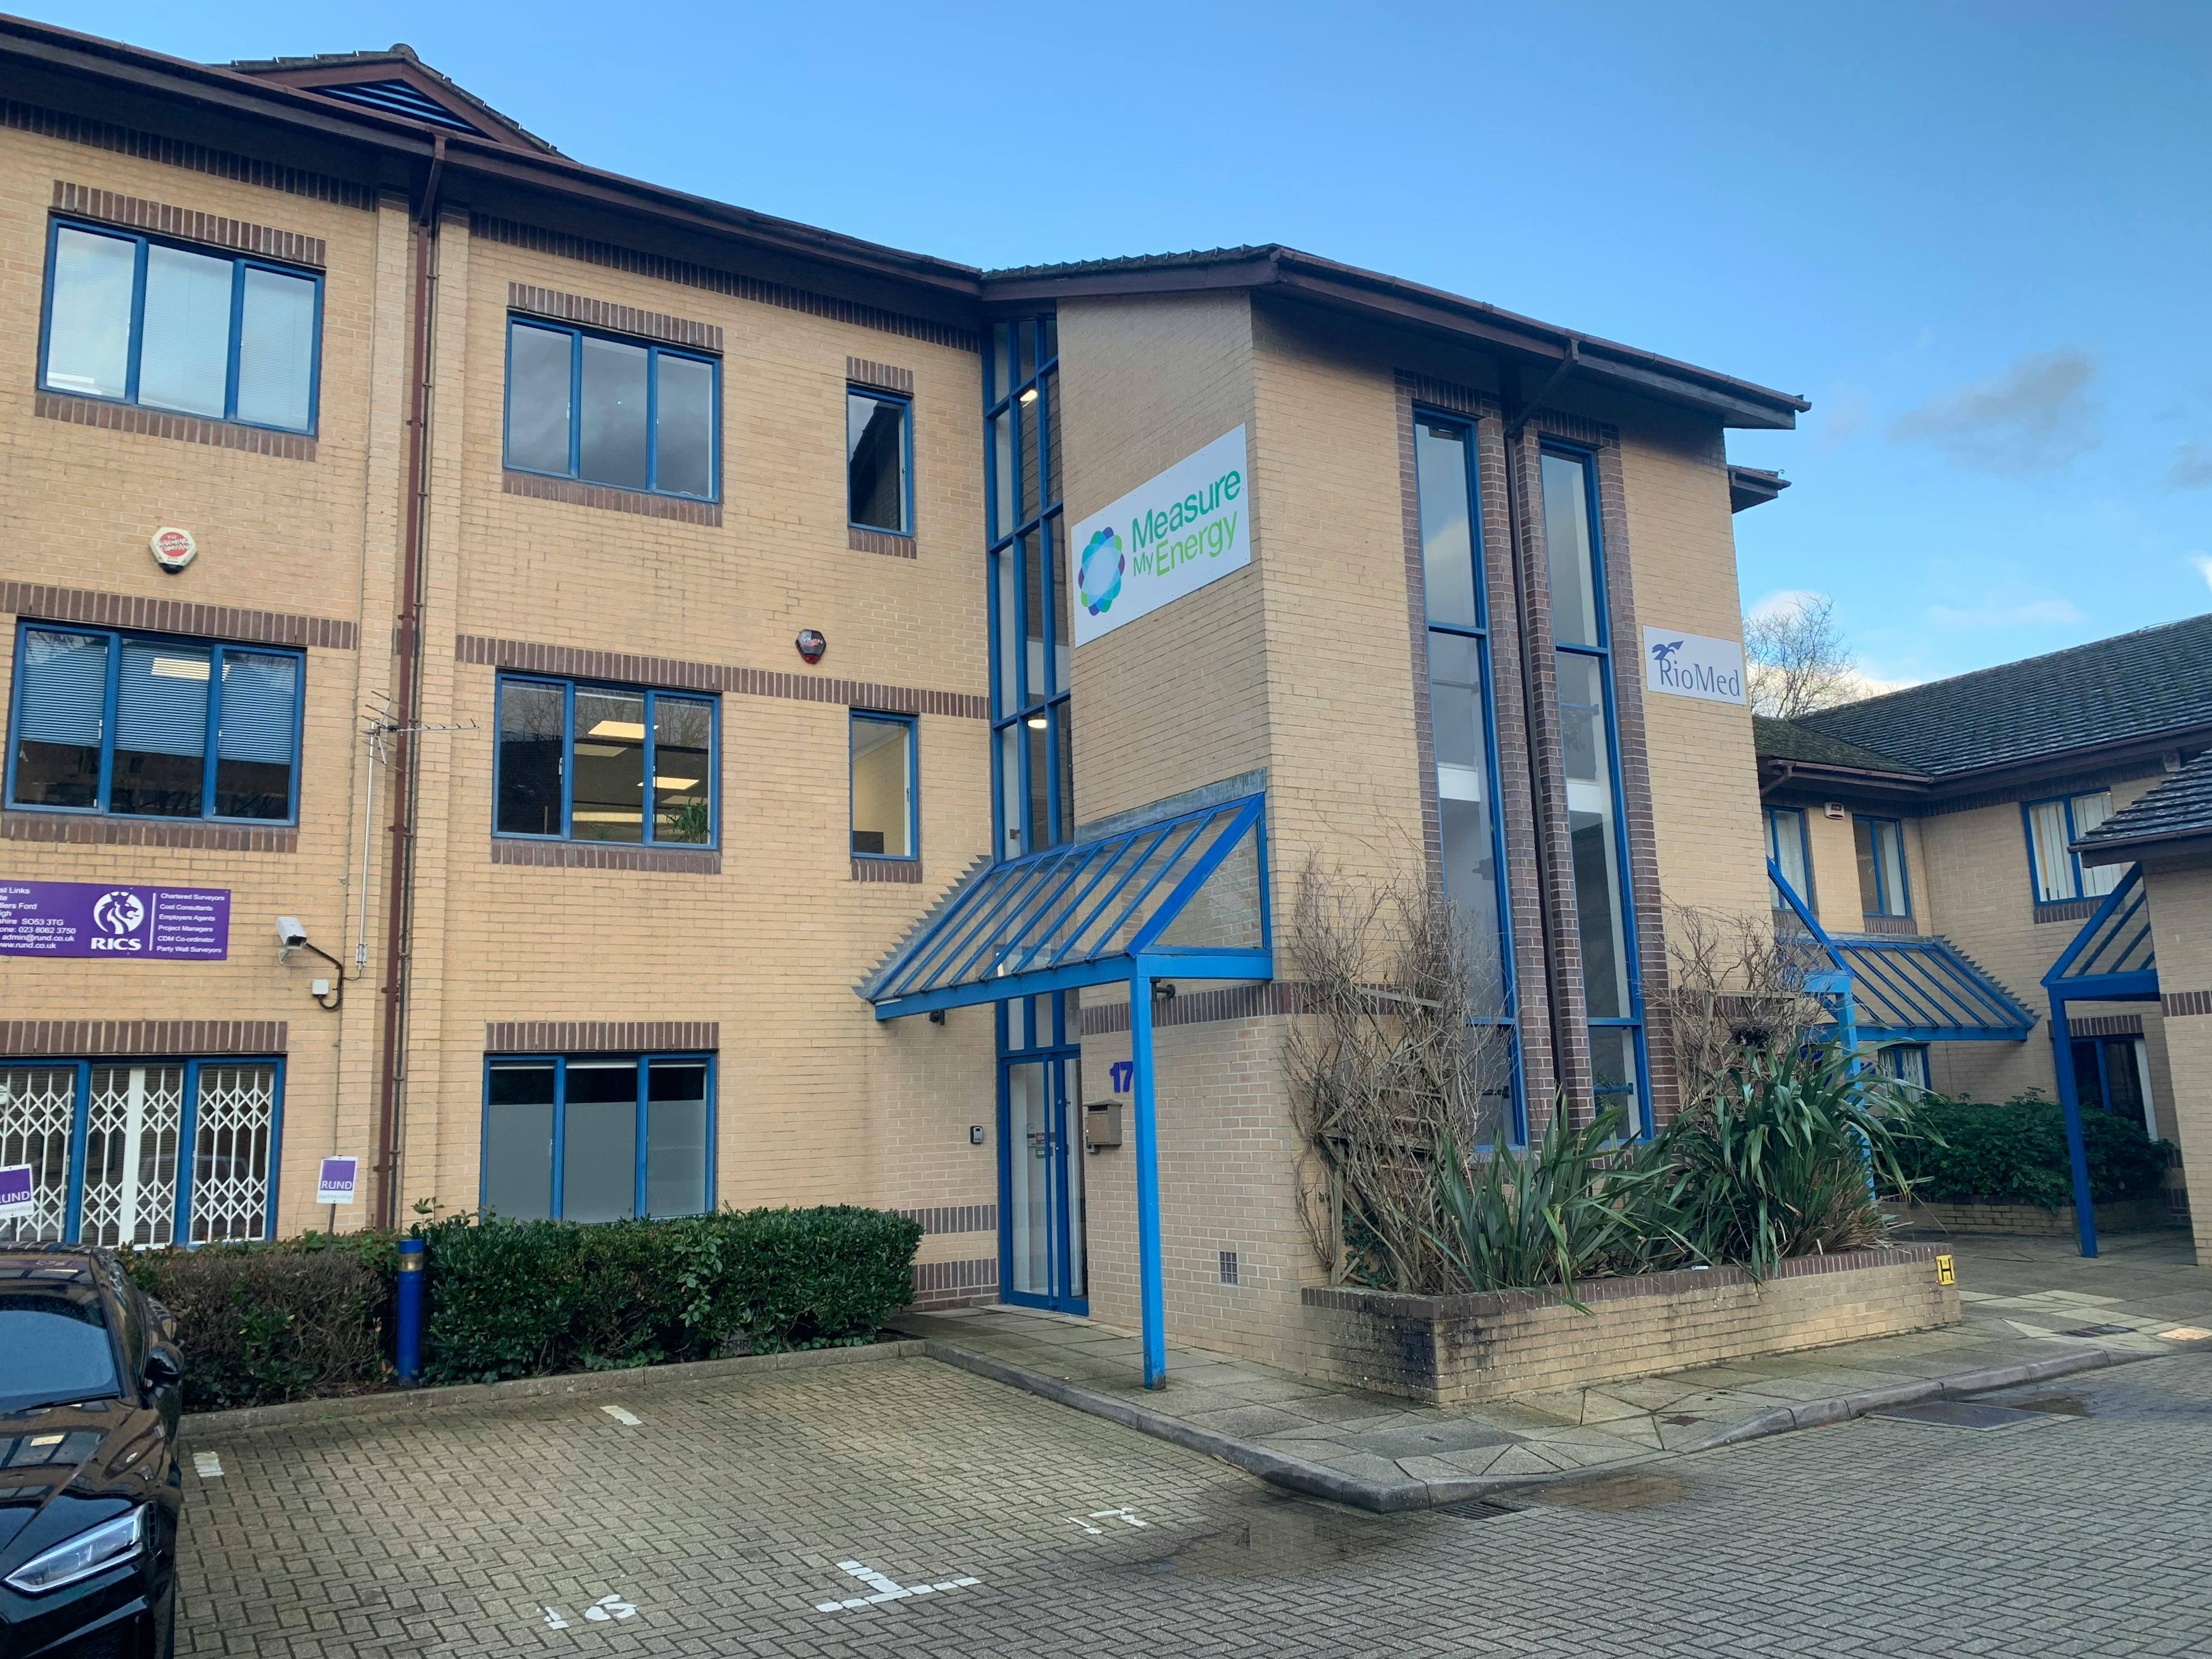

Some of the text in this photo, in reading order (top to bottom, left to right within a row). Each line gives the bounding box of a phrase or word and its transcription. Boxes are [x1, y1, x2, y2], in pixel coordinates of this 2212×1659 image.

[1131, 470, 1241, 553] Measure
[1133, 511, 1238, 577] My Energy
[1659, 658, 1741, 697] RioMed
[2, 934, 75, 942] admin@rund.co.uk
[91, 937, 142, 951] RICS
[1109, 1061, 1133, 1093] 17
[321, 1180, 352, 1189] RUND
[0, 1191, 30, 1204] UND
[1940, 1258, 1953, 1282] H
